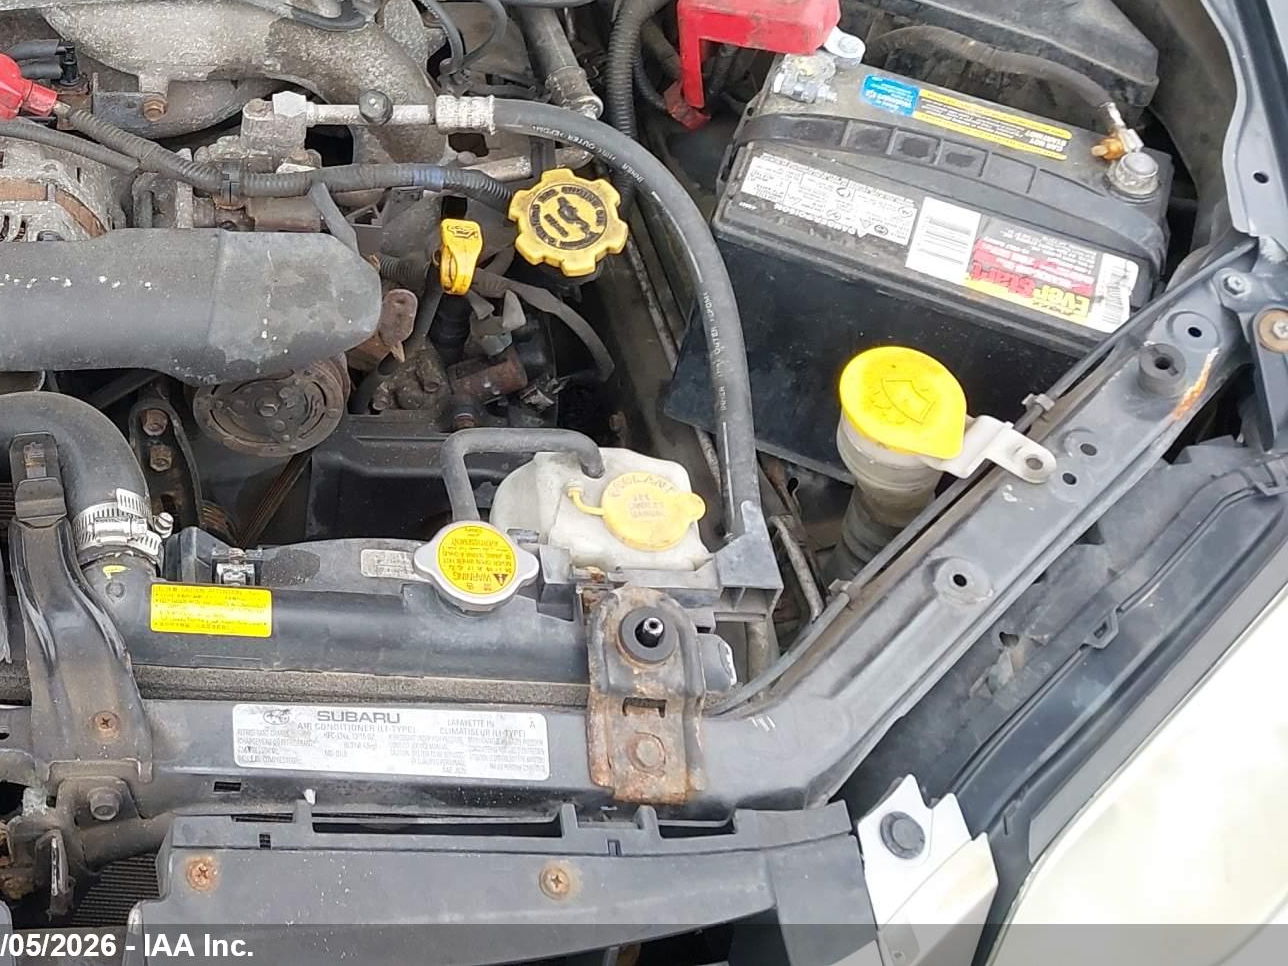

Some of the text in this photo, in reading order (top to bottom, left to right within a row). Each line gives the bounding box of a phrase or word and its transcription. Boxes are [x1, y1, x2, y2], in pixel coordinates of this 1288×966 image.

[567, 135, 596, 150] OUTER
[710, 326, 721, 355] OUTER
[452, 571, 492, 582] WARNING
[316, 710, 400, 724] SUBARU
[314, 723, 375, 733] CONDITIONER
